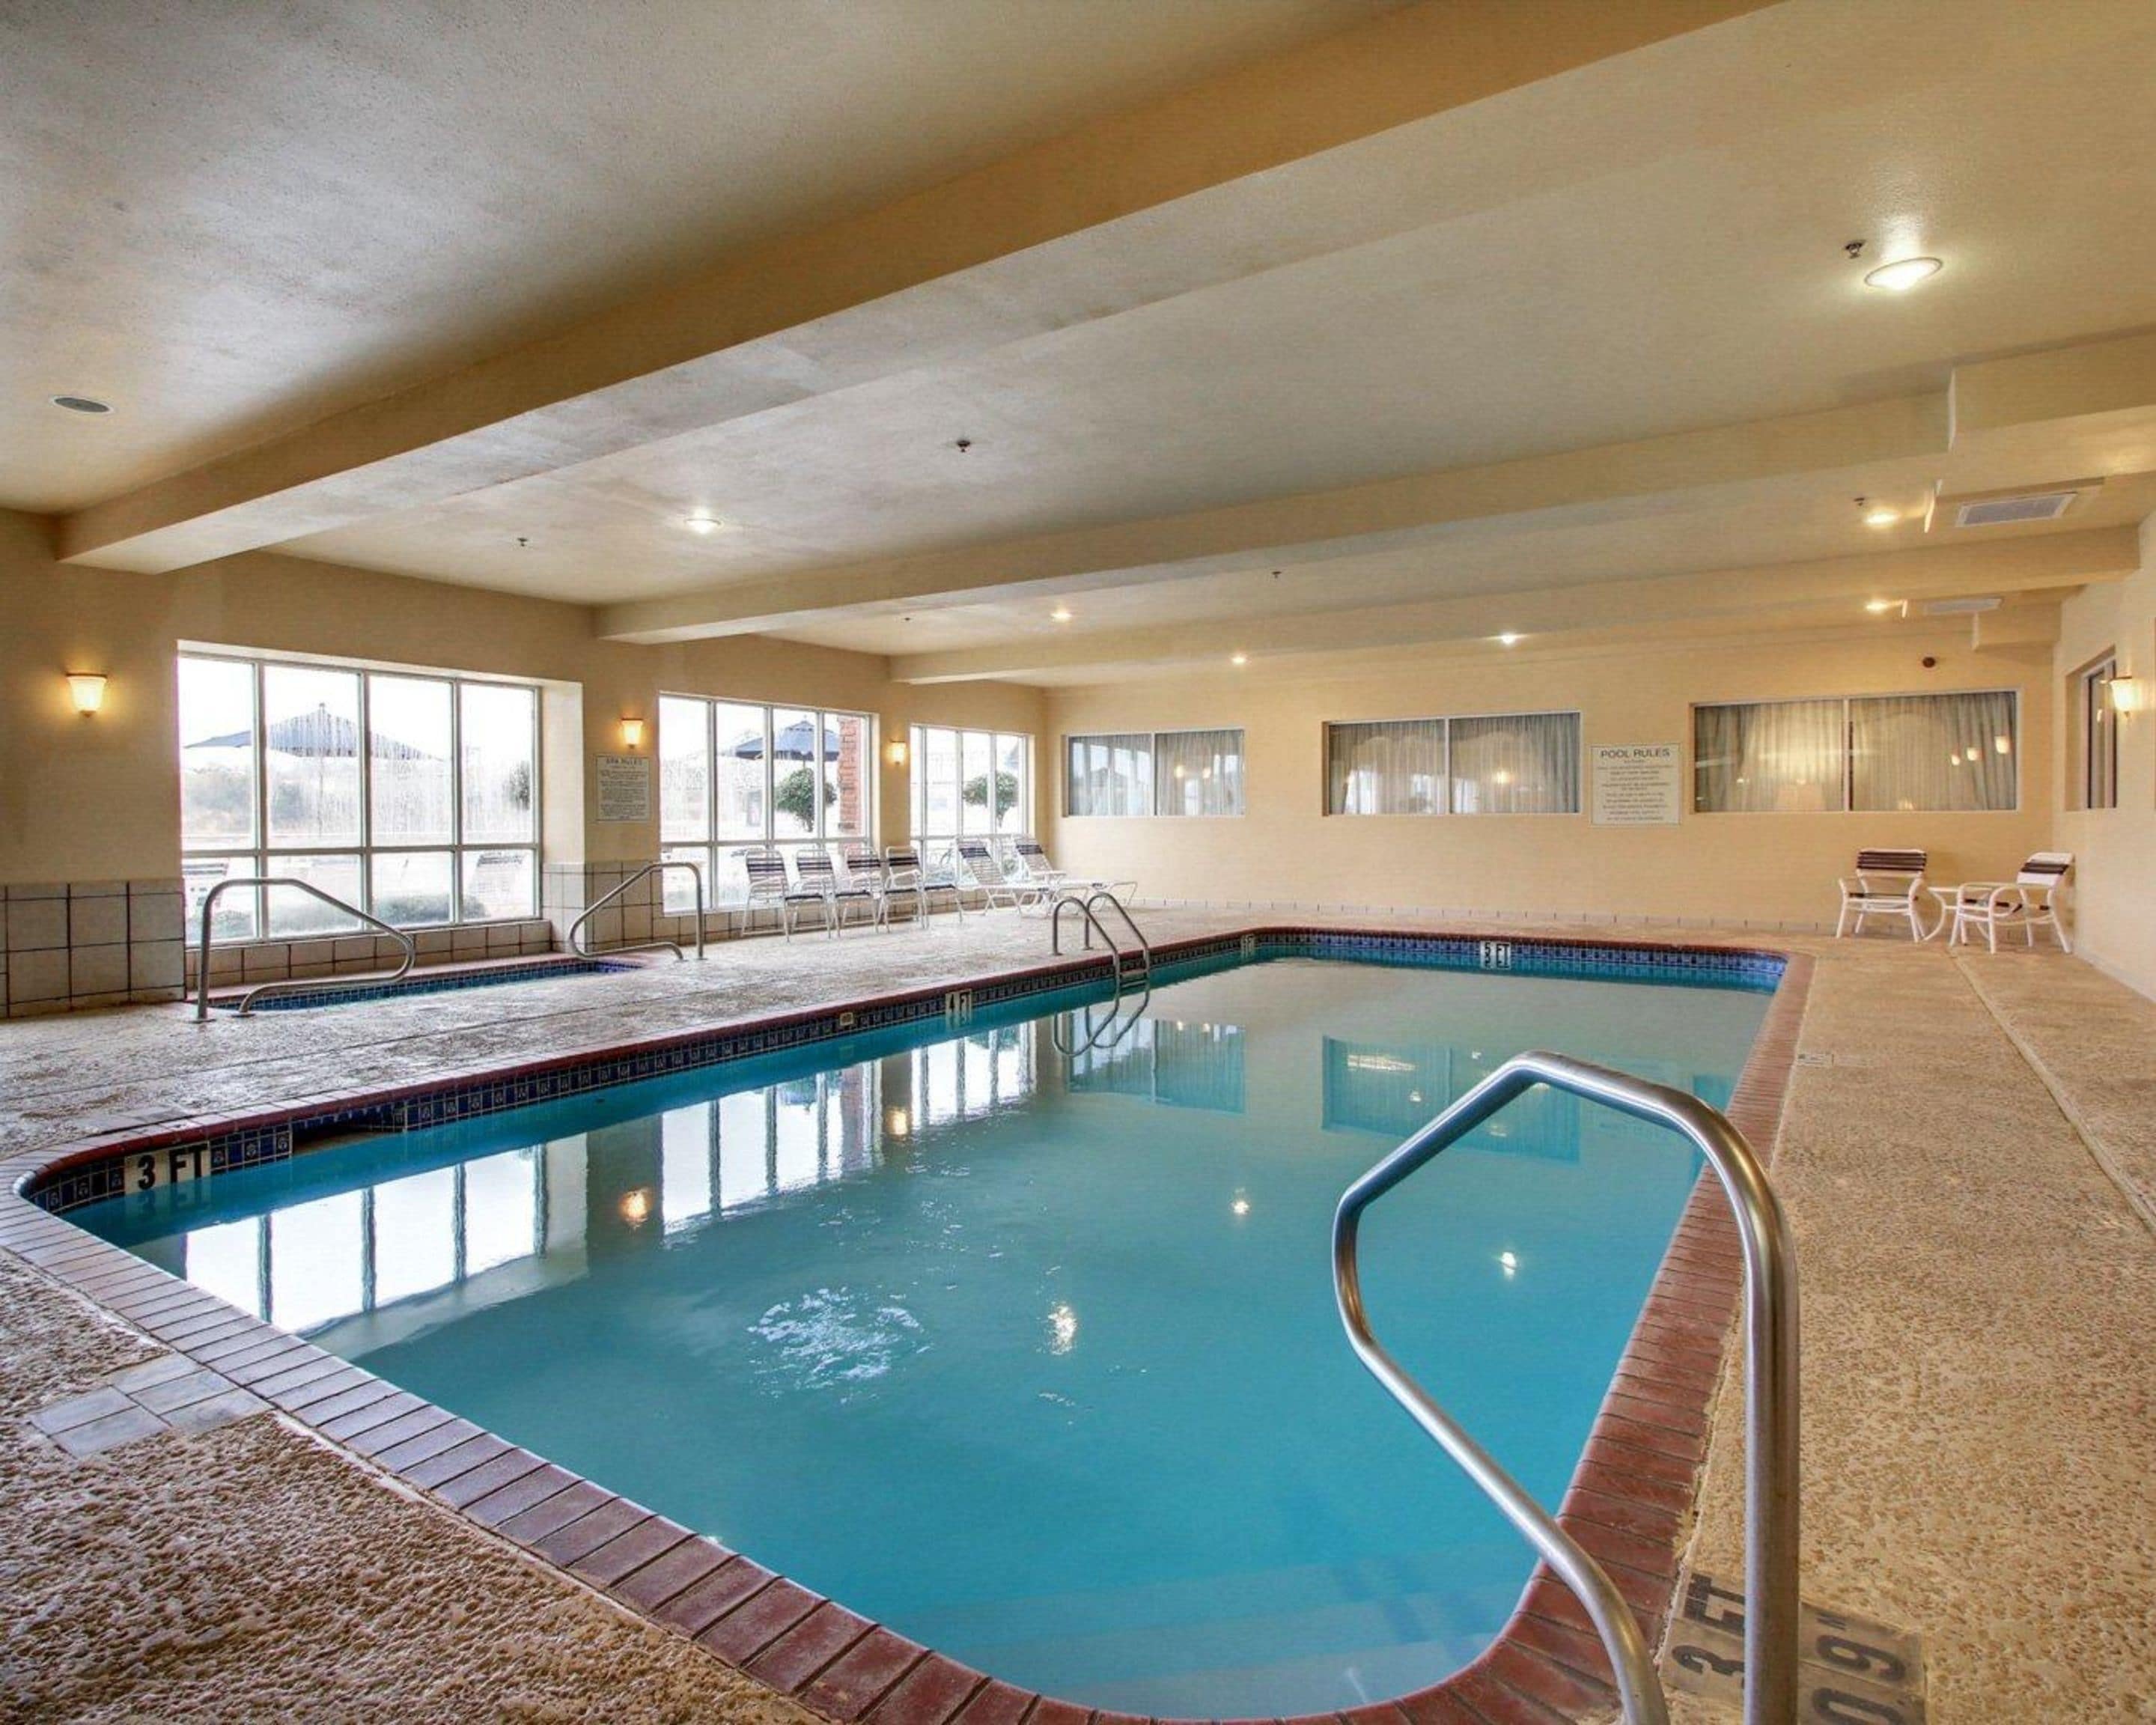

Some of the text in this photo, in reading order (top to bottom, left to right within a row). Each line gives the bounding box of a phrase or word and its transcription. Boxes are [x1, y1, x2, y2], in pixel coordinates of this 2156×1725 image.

[1601, 747, 1671, 758] POOL RULES
[1484, 942, 1510, 956] 5 FT
[948, 994, 955, 1013] 4
[138, 1143, 208, 1190] 3 FT
